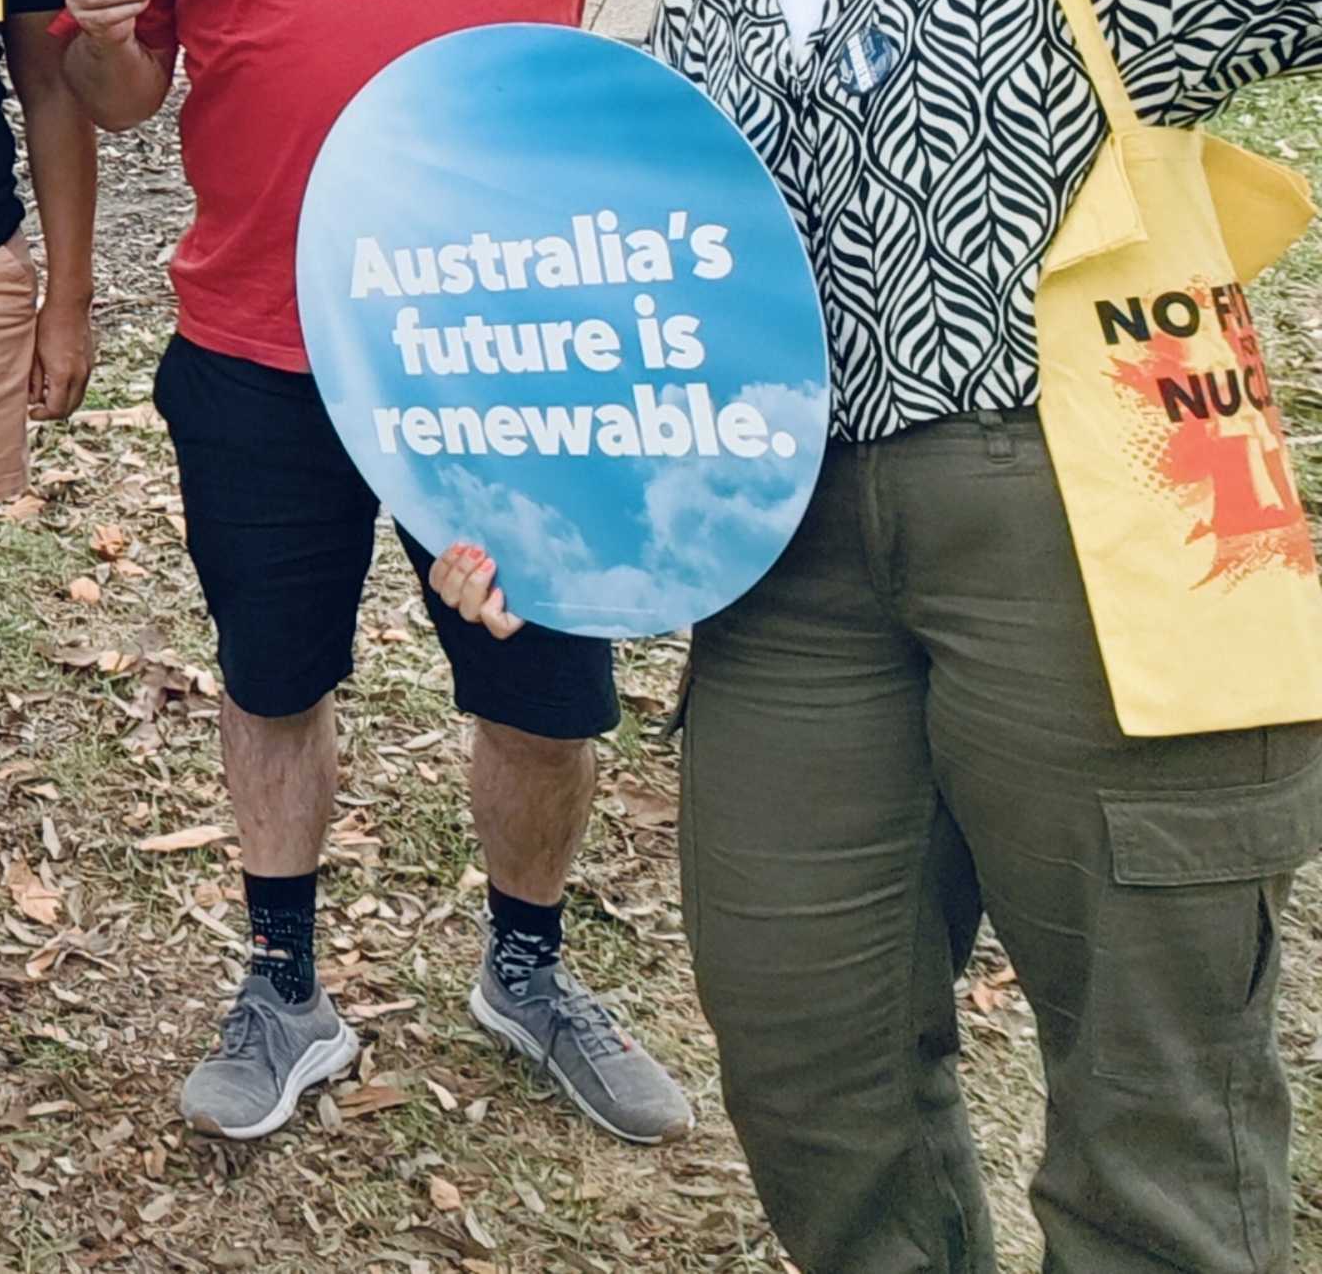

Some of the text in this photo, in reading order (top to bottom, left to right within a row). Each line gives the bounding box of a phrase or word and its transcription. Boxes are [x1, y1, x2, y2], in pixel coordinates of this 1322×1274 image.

[349, 209, 733, 299] Australia's
[392, 293, 706, 376] future is
[1094, 290, 1201, 345] NO
[373, 383, 797, 459] renewable.
